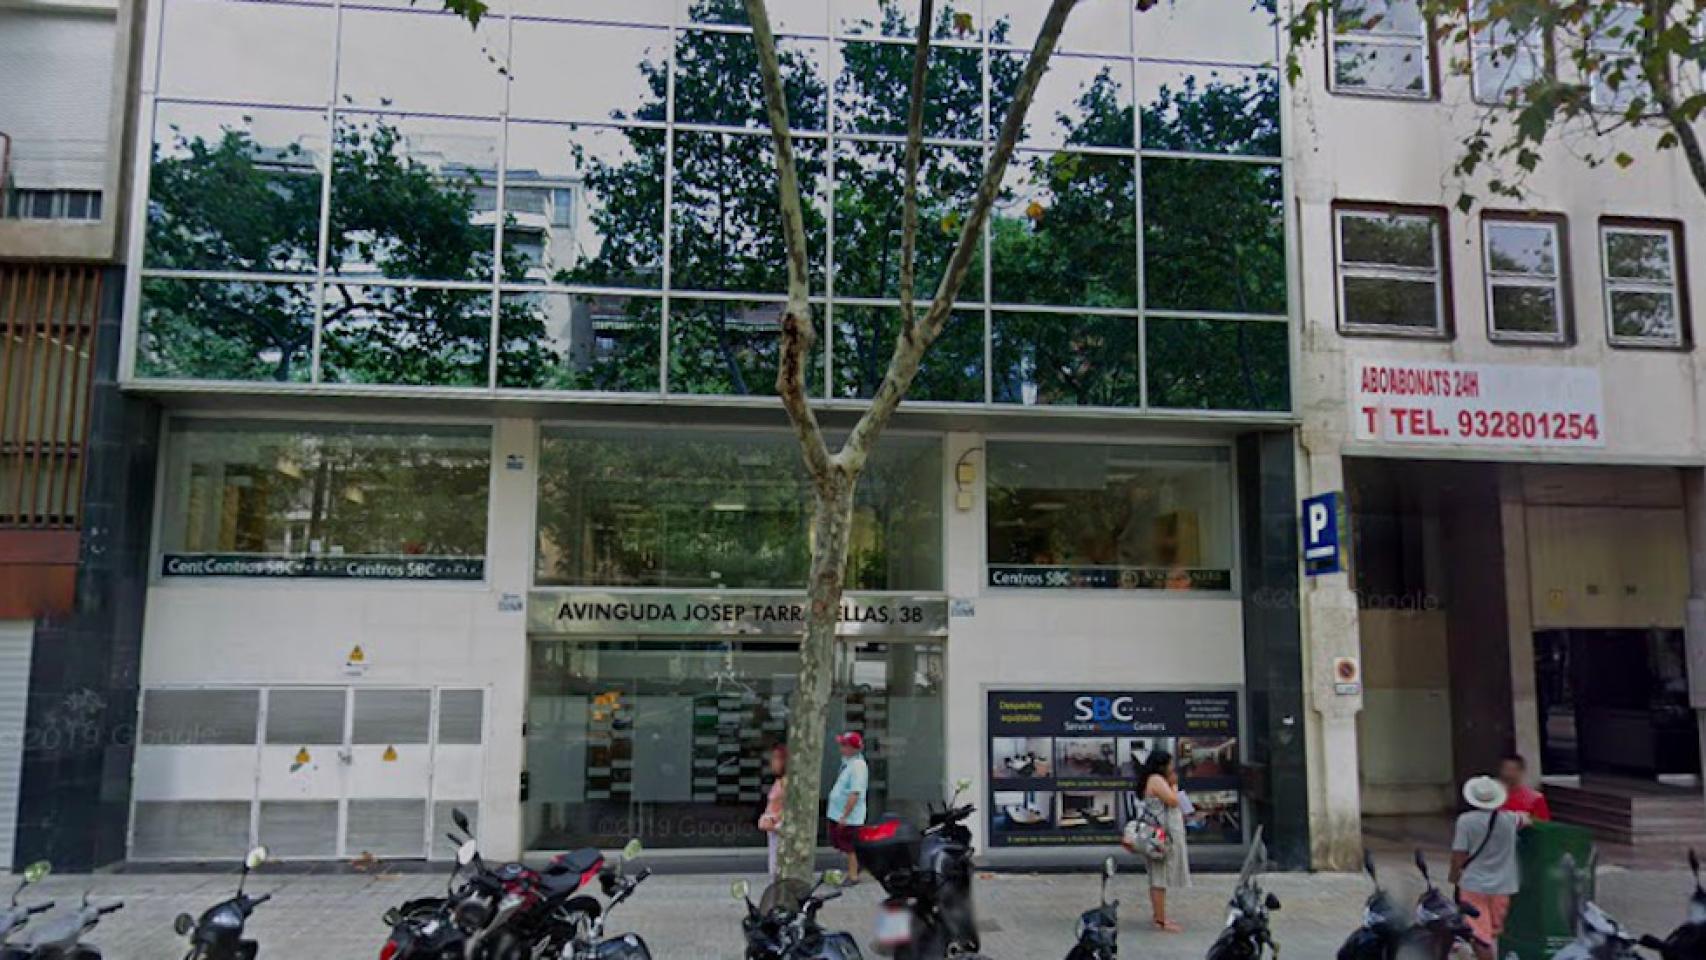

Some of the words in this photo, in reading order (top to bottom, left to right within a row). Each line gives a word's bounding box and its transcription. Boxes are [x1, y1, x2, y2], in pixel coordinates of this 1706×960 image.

[1454, 370, 1480, 397] 24H
[1362, 406, 1377, 434] T
[1391, 408, 1449, 436] TEL.
[1457, 409, 1600, 439] 932801254
[1309, 503, 1328, 543] P
[346, 562, 403, 577] Centros
[406, 562, 437, 577] SBC
[992, 570, 1042, 586] Centros
[1045, 570, 1070, 586] SBC
[557, 603, 676, 622] AVINGUDA
[682, 603, 745, 622] JOSEP
[900, 605, 923, 623] 38
[1074, 696, 1134, 721] SBC
